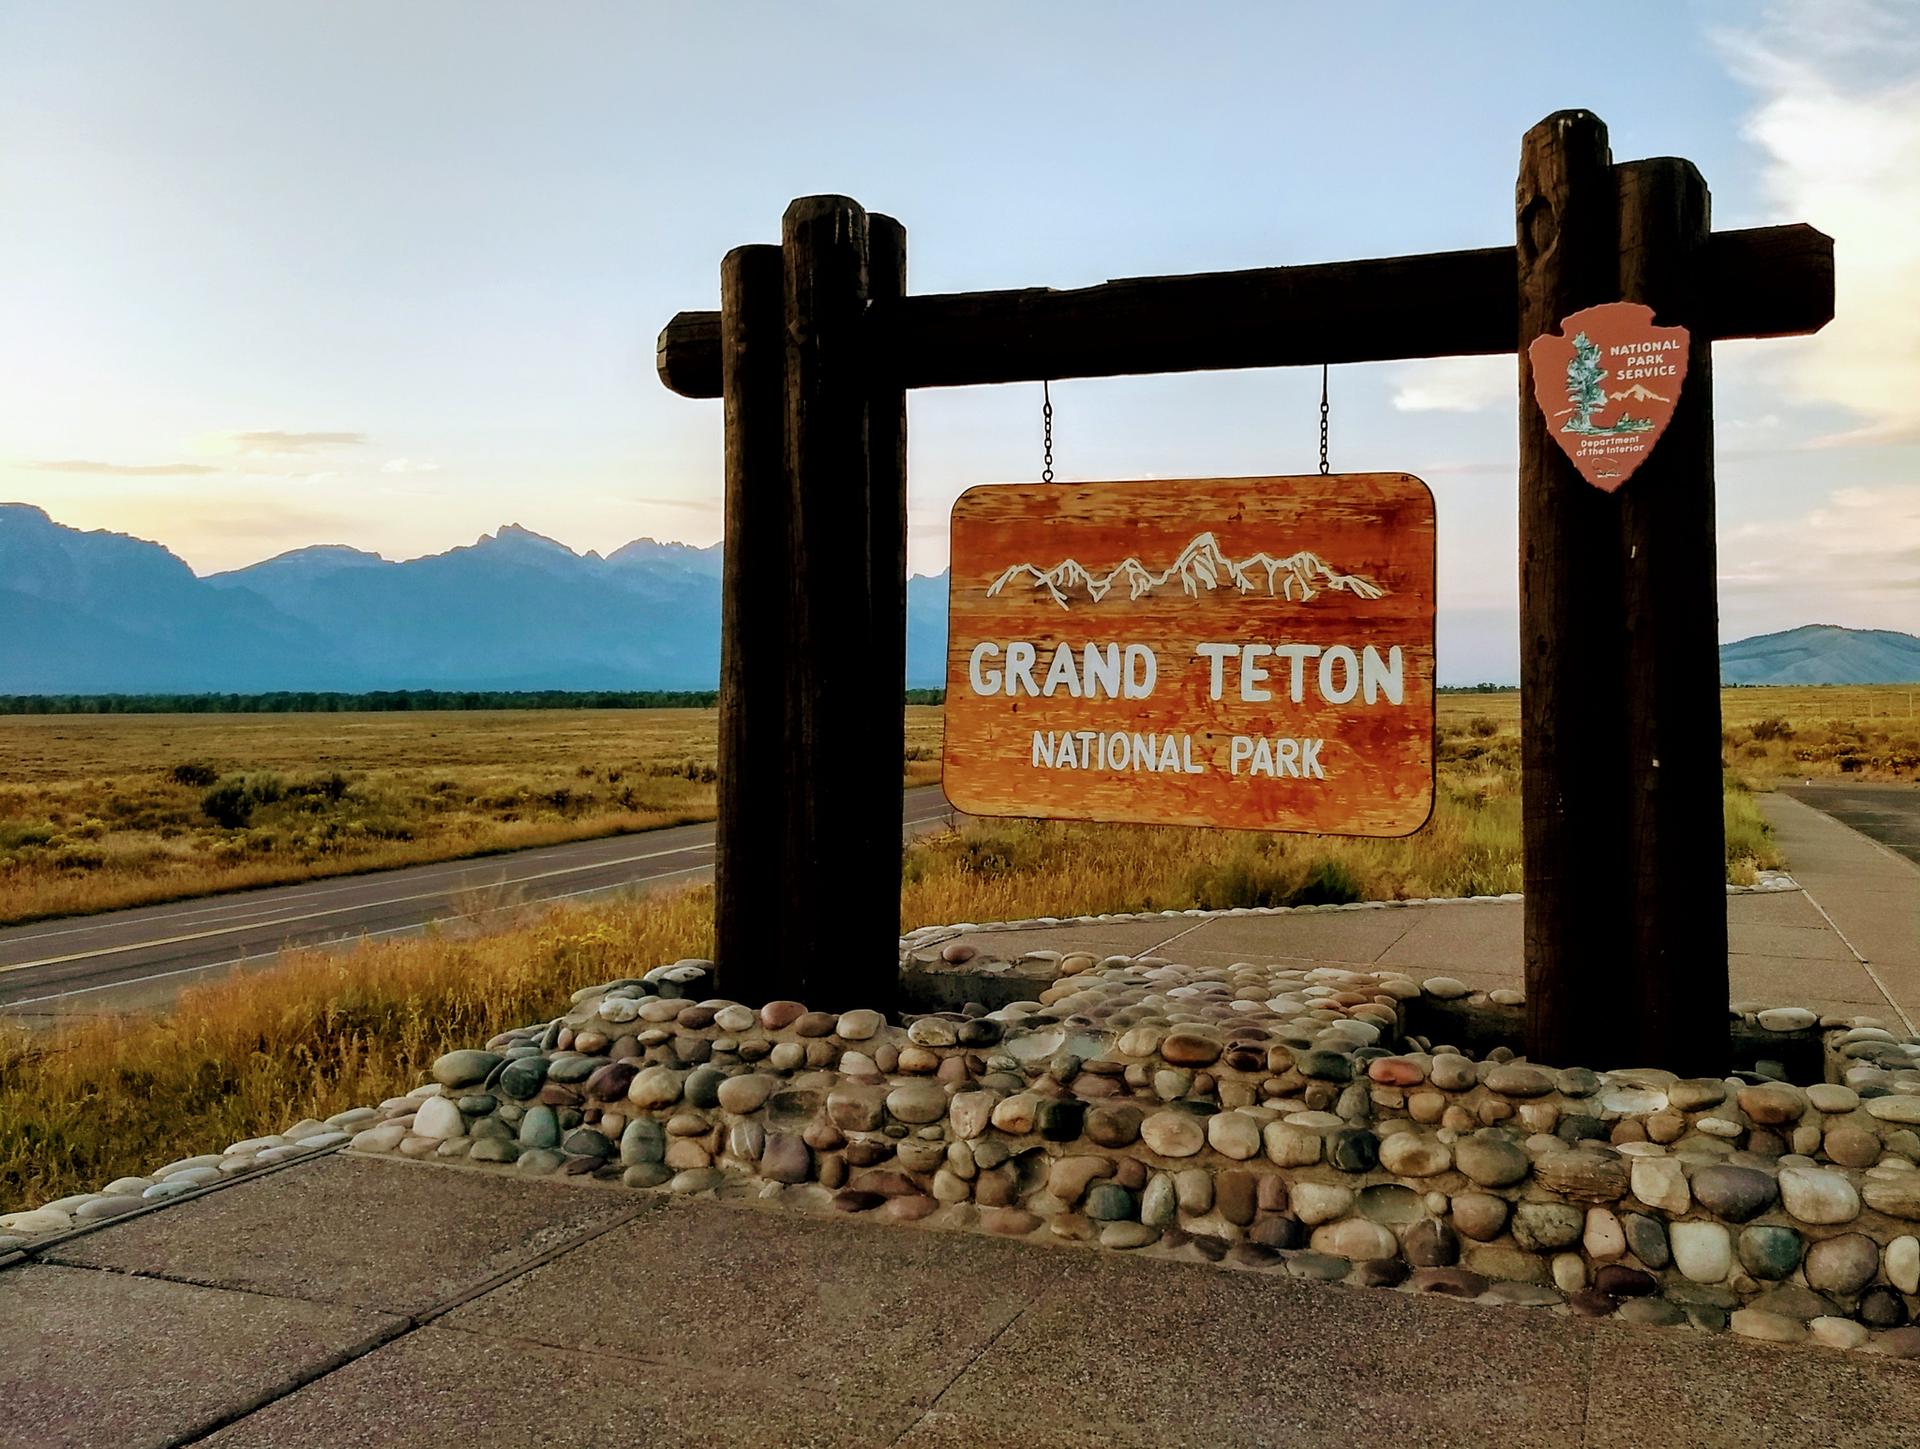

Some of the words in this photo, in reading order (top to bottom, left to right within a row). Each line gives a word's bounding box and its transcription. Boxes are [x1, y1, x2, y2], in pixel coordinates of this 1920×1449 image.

[1610, 340, 1680, 356] NATIONAL
[1627, 354, 1664, 366] PARK
[1616, 365, 1677, 381] SERVICE
[1580, 435, 1639, 449] Department
[1576, 447, 1587, 457] of
[1588, 446, 1604, 456] the
[1606, 444, 1645, 454] Interior
[969, 641, 1157, 699] GRAND
[1196, 644, 1404, 705] TETON
[1032, 730, 1203, 774] NATIONAL
[1230, 735, 1326, 779] PARK
